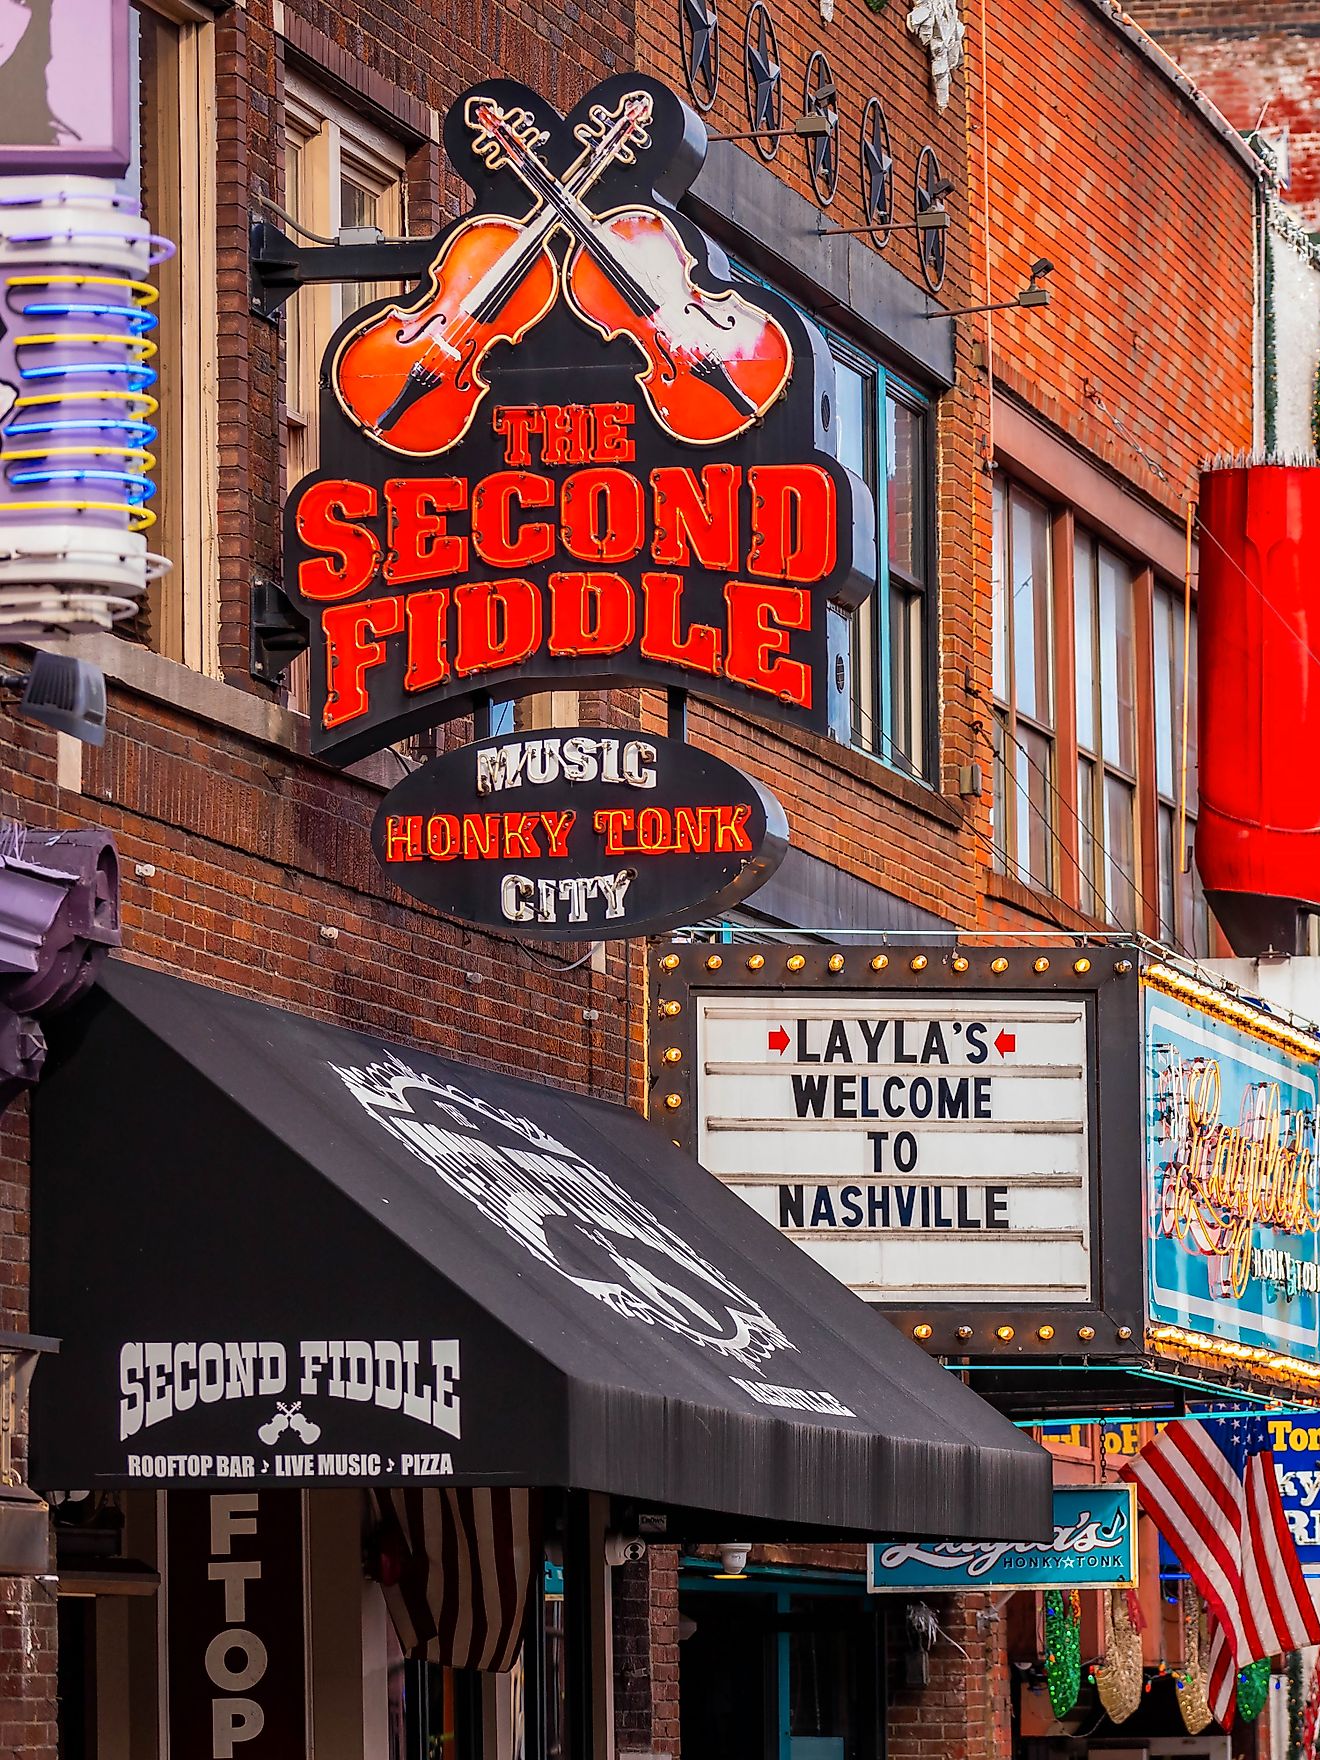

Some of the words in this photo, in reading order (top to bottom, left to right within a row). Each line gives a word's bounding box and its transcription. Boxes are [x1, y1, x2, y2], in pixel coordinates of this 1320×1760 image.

[493, 403, 636, 466] THE
[296, 464, 837, 600] SECOND
[321, 571, 812, 731] FIDDLE
[476, 737, 658, 795] MUSIC
[385, 808, 577, 863] HONKY
[593, 804, 754, 856] TONK
[501, 869, 637, 923] CITY
[796, 1018, 989, 1065] LAYLA'S
[790, 1074, 993, 1119] WELCOME
[866, 1130, 918, 1173] TO
[778, 1184, 1010, 1229] NASHVILLE
[119, 1341, 287, 1442] SECOND
[300, 1339, 462, 1440] FIDDLE
[727, 1375, 858, 1418] NASHVILLE
[128, 1454, 213, 1478] ROOFTOP
[216, 1455, 256, 1478] BAR
[275, 1455, 315, 1477] LIVE
[317, 1453, 382, 1476] MUSIC
[401, 1453, 454, 1476] PIZZA
[1003, 1555, 1062, 1570] HONKY
[1076, 1554, 1124, 1569] TONK
[204, 1493, 268, 1759] FTOP
